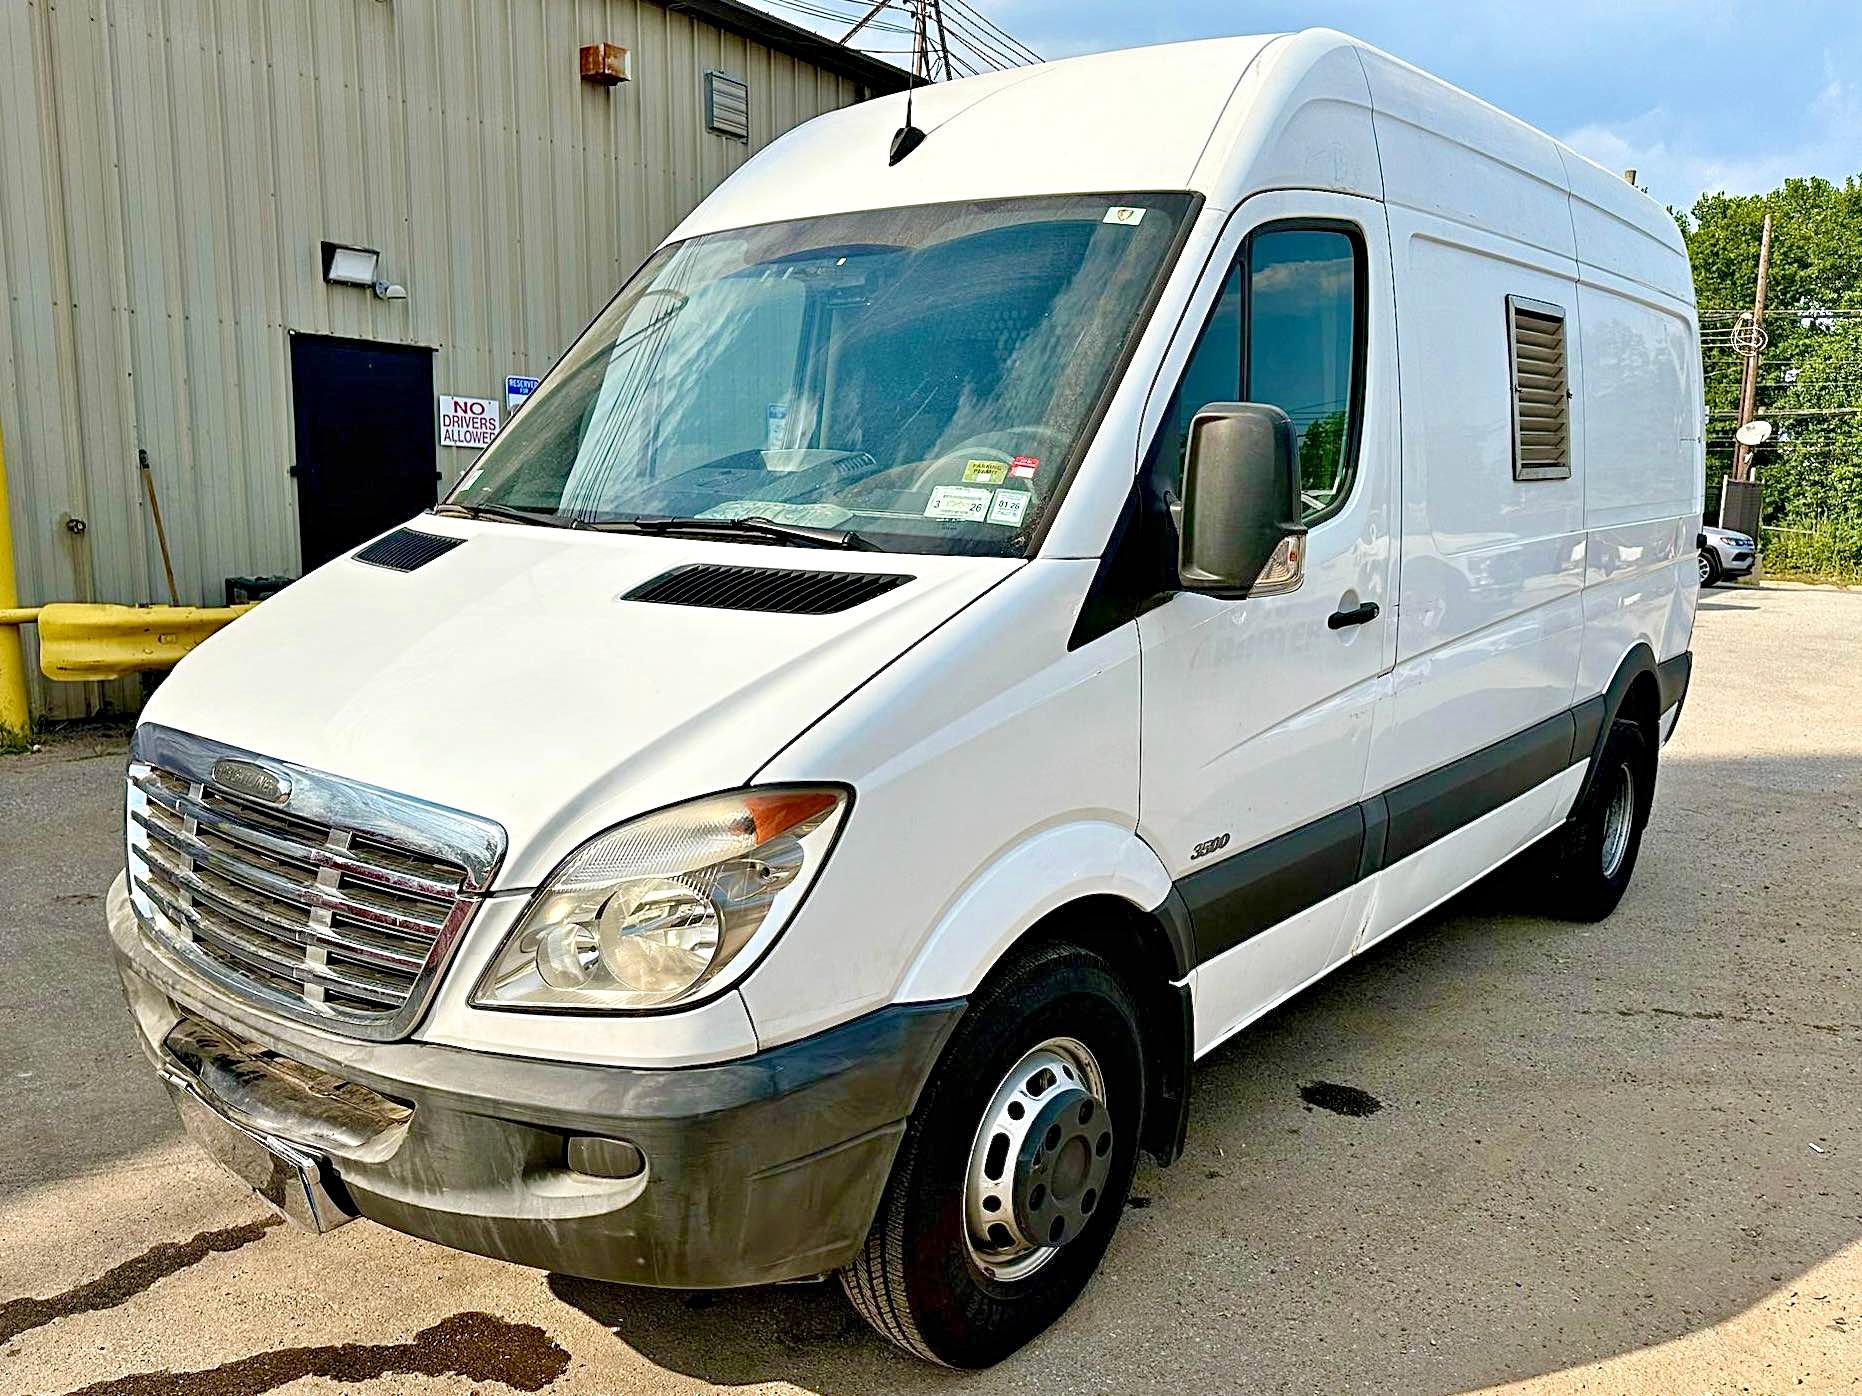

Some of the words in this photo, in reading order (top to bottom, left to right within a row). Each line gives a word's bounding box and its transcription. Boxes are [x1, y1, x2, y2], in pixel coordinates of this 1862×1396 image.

[453, 401, 485, 415] NO
[443, 414, 496, 431] DRIVERS
[973, 463, 1001, 471] PARKING
[934, 500, 940, 509] 3
[969, 503, 982, 513] 26
[1190, 833, 1231, 860] 3500
